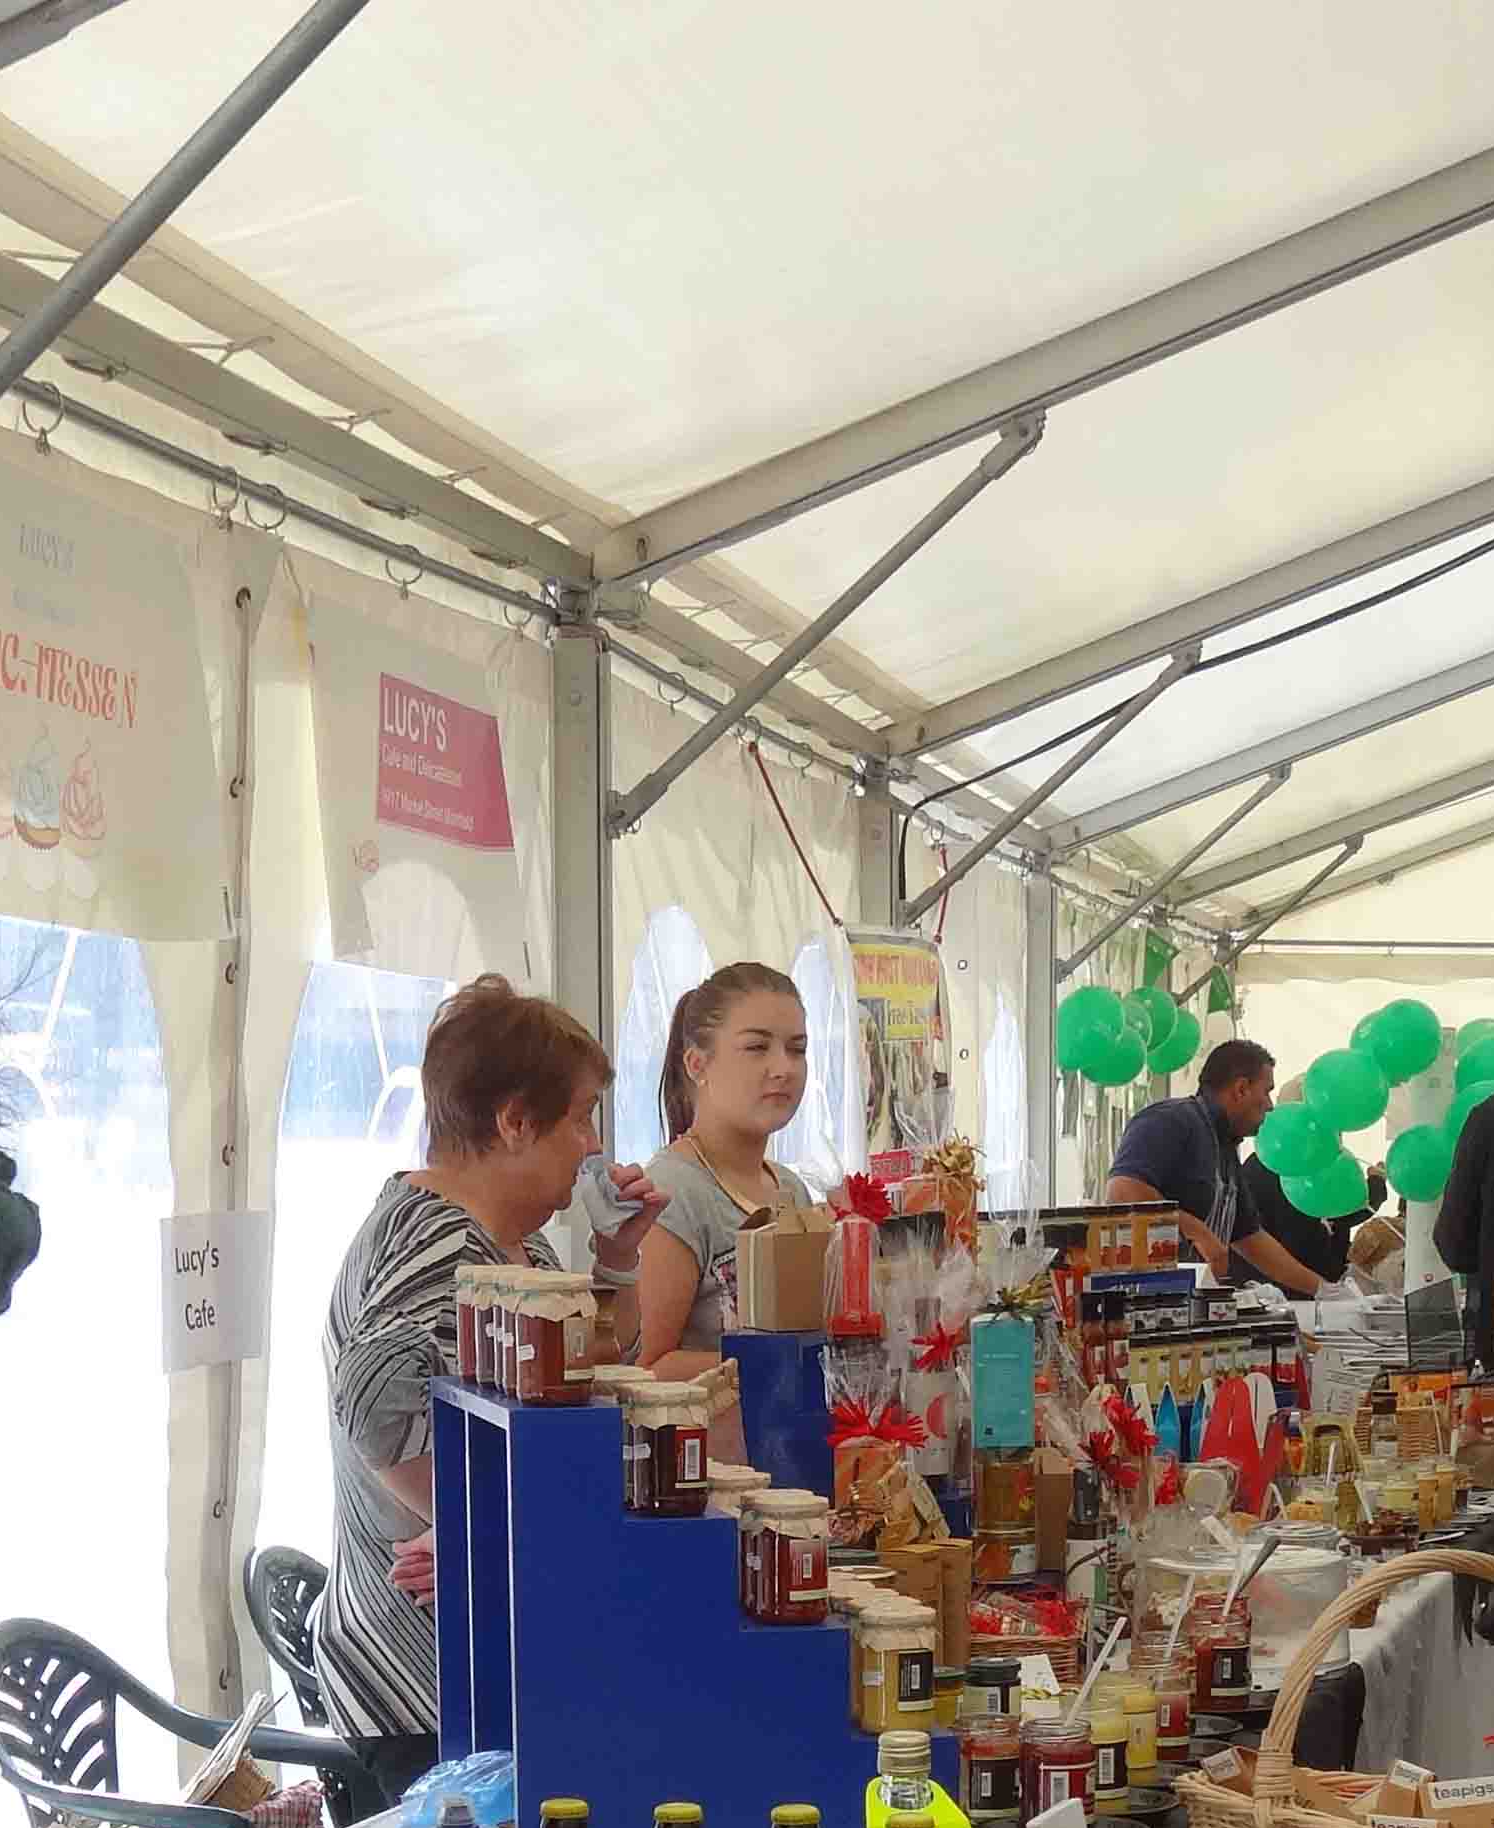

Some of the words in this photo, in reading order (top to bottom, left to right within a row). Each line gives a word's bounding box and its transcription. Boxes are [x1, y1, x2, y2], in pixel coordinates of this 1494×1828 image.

[383, 687, 448, 752] LUCY'S
[174, 1240, 219, 1277] Lucy's
[185, 1299, 216, 1330] Cafe
